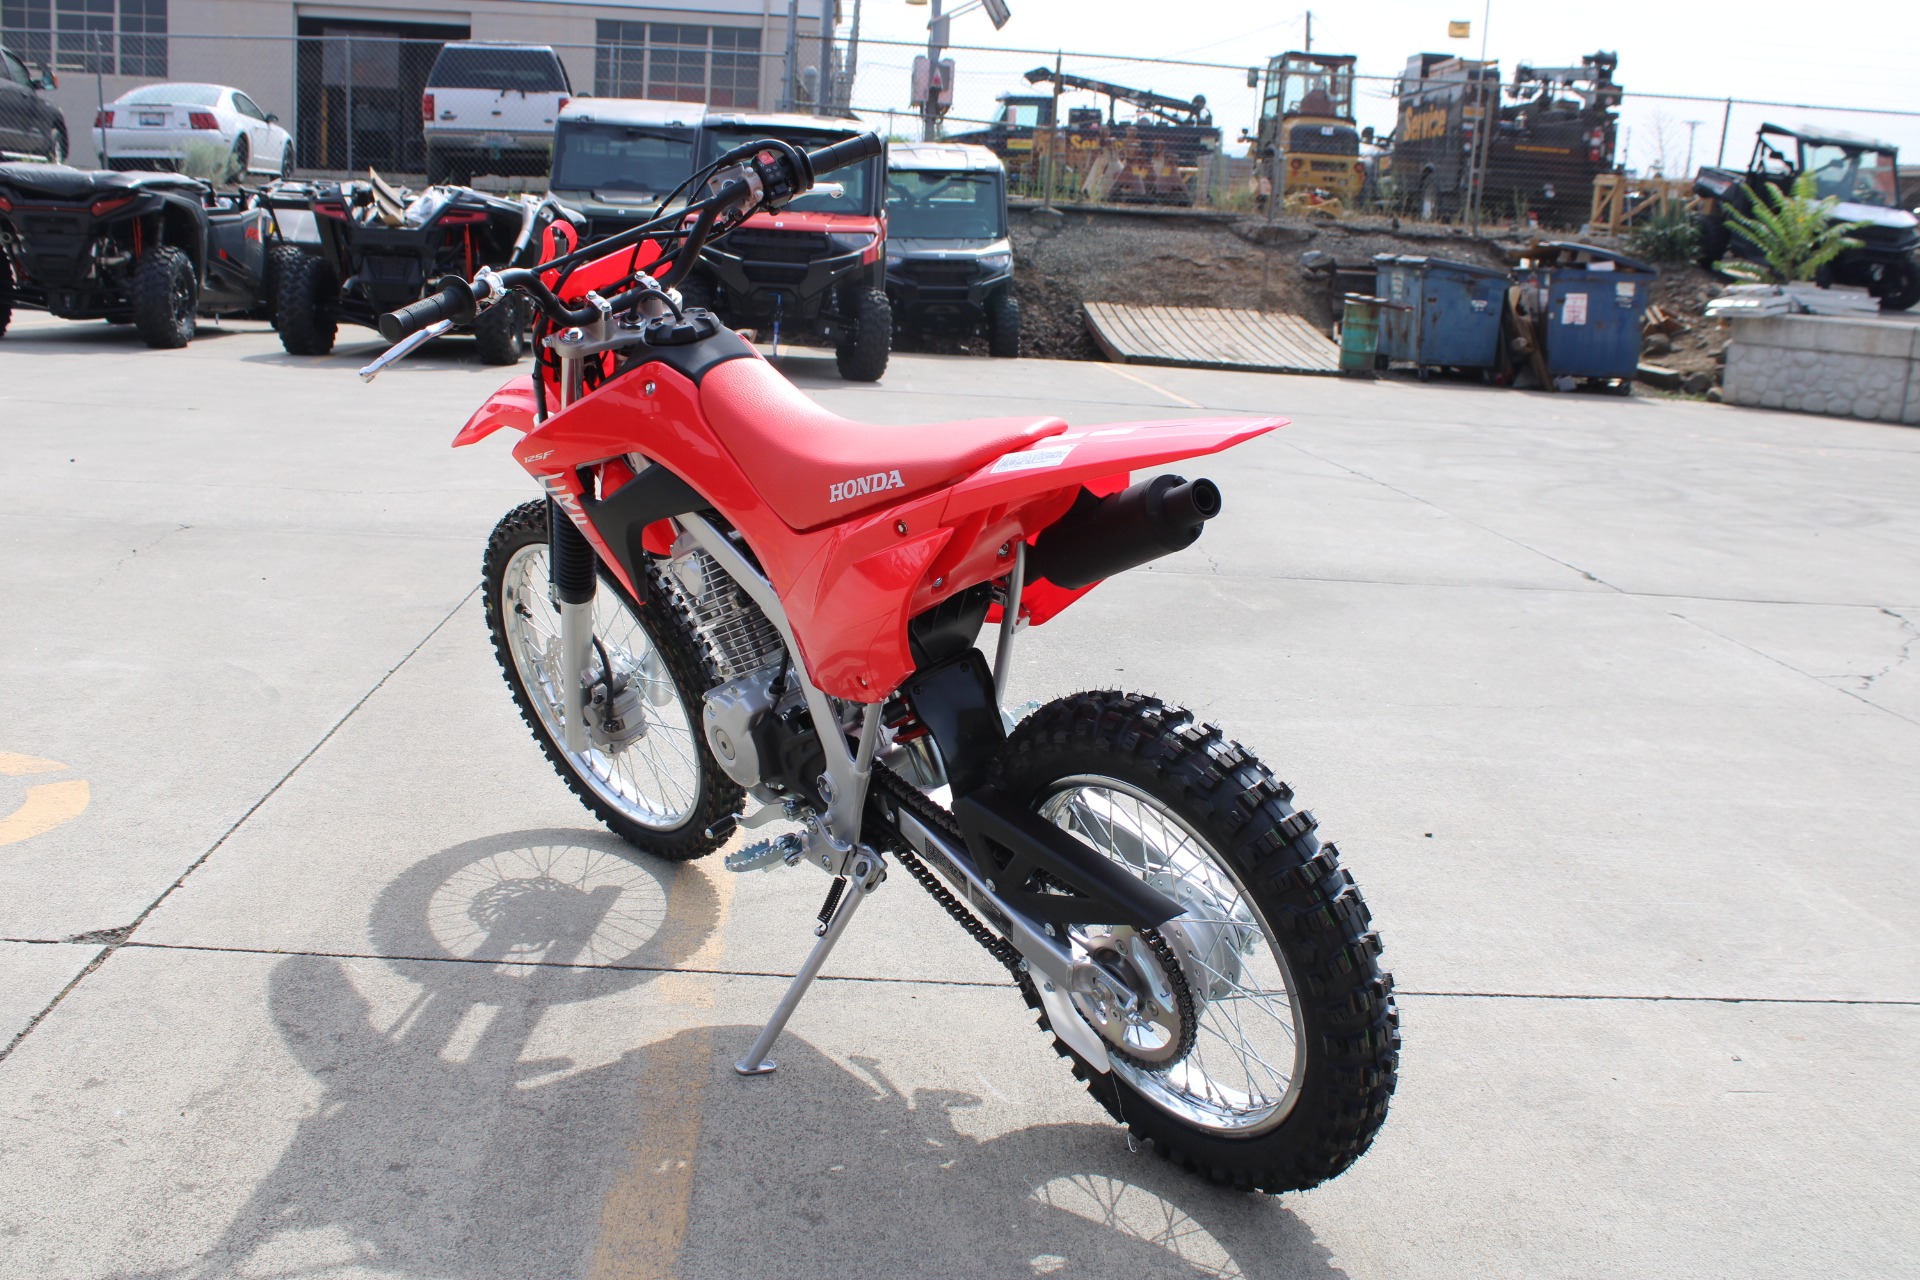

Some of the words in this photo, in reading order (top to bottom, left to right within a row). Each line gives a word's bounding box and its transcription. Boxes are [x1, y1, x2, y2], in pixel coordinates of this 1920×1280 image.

[1403, 103, 1447, 141] Service
[523, 449, 555, 464] 125F
[829, 469, 905, 503] HONDA
